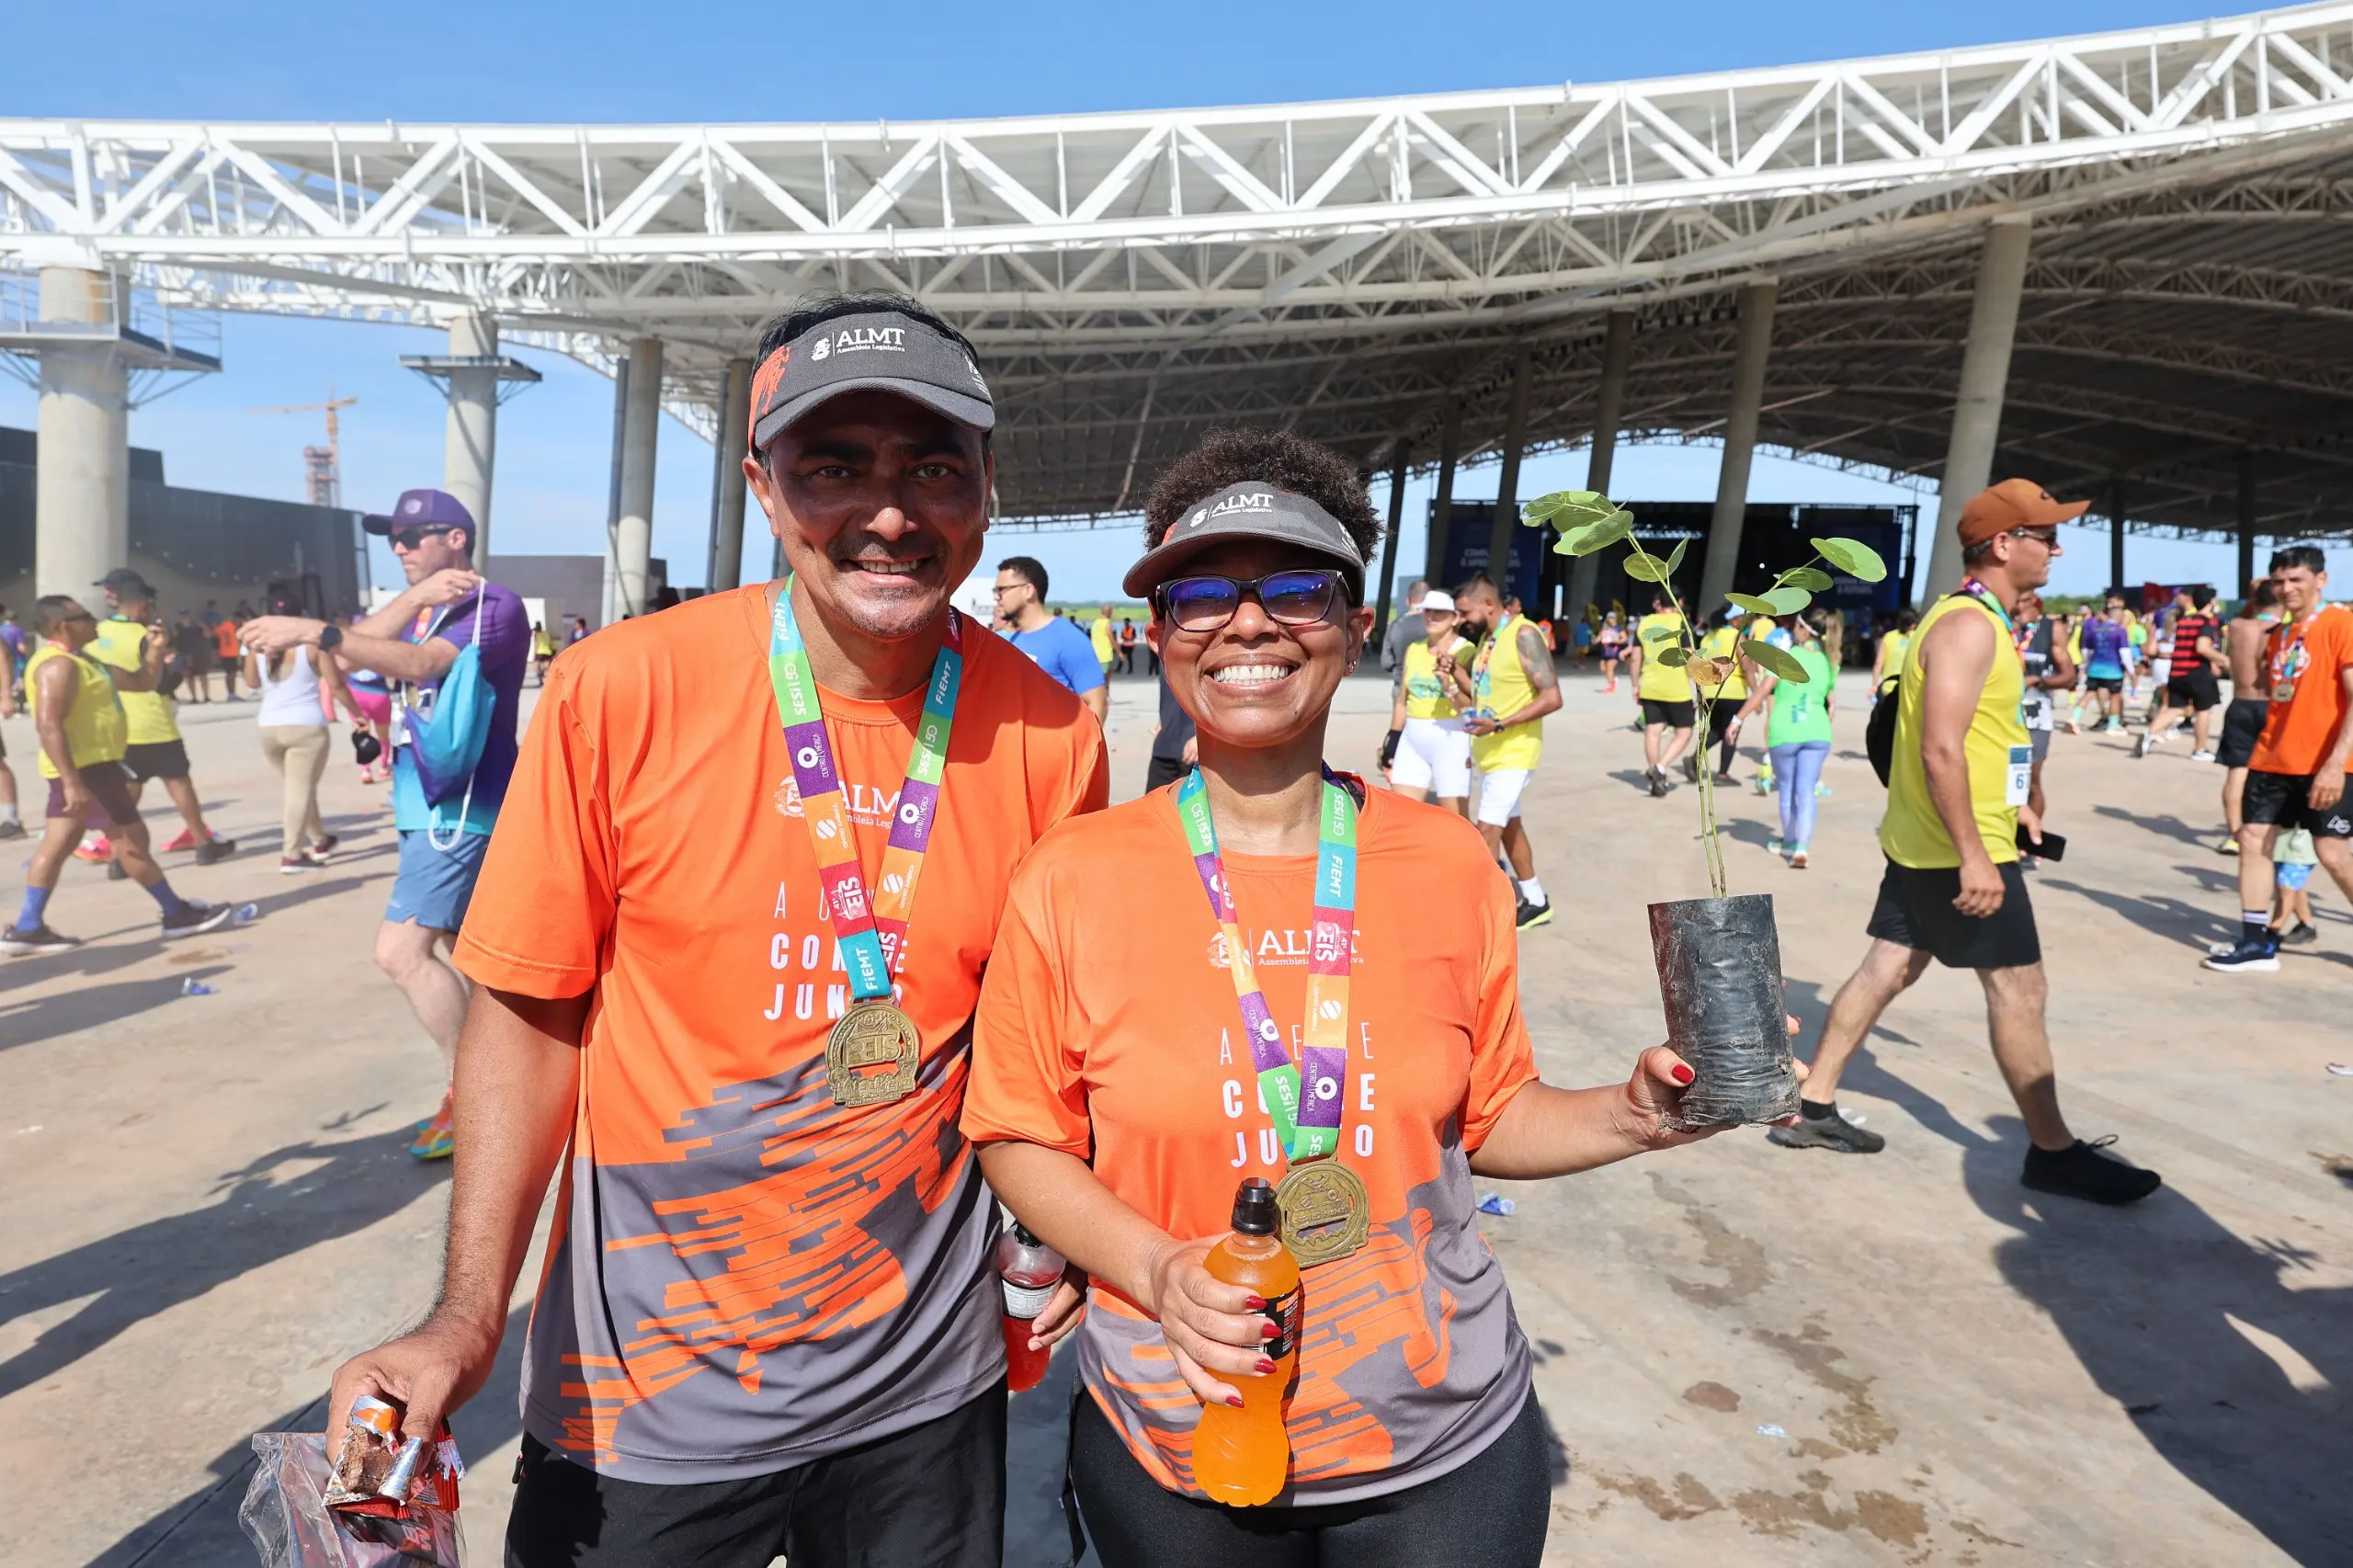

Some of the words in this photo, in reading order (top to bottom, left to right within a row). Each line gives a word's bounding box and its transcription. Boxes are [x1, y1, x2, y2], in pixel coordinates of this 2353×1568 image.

[836, 327, 905, 347] ALMT
[1211, 493, 1273, 514] ALMT
[774, 881, 786, 919] A
[1220, 1028, 1232, 1065] A
